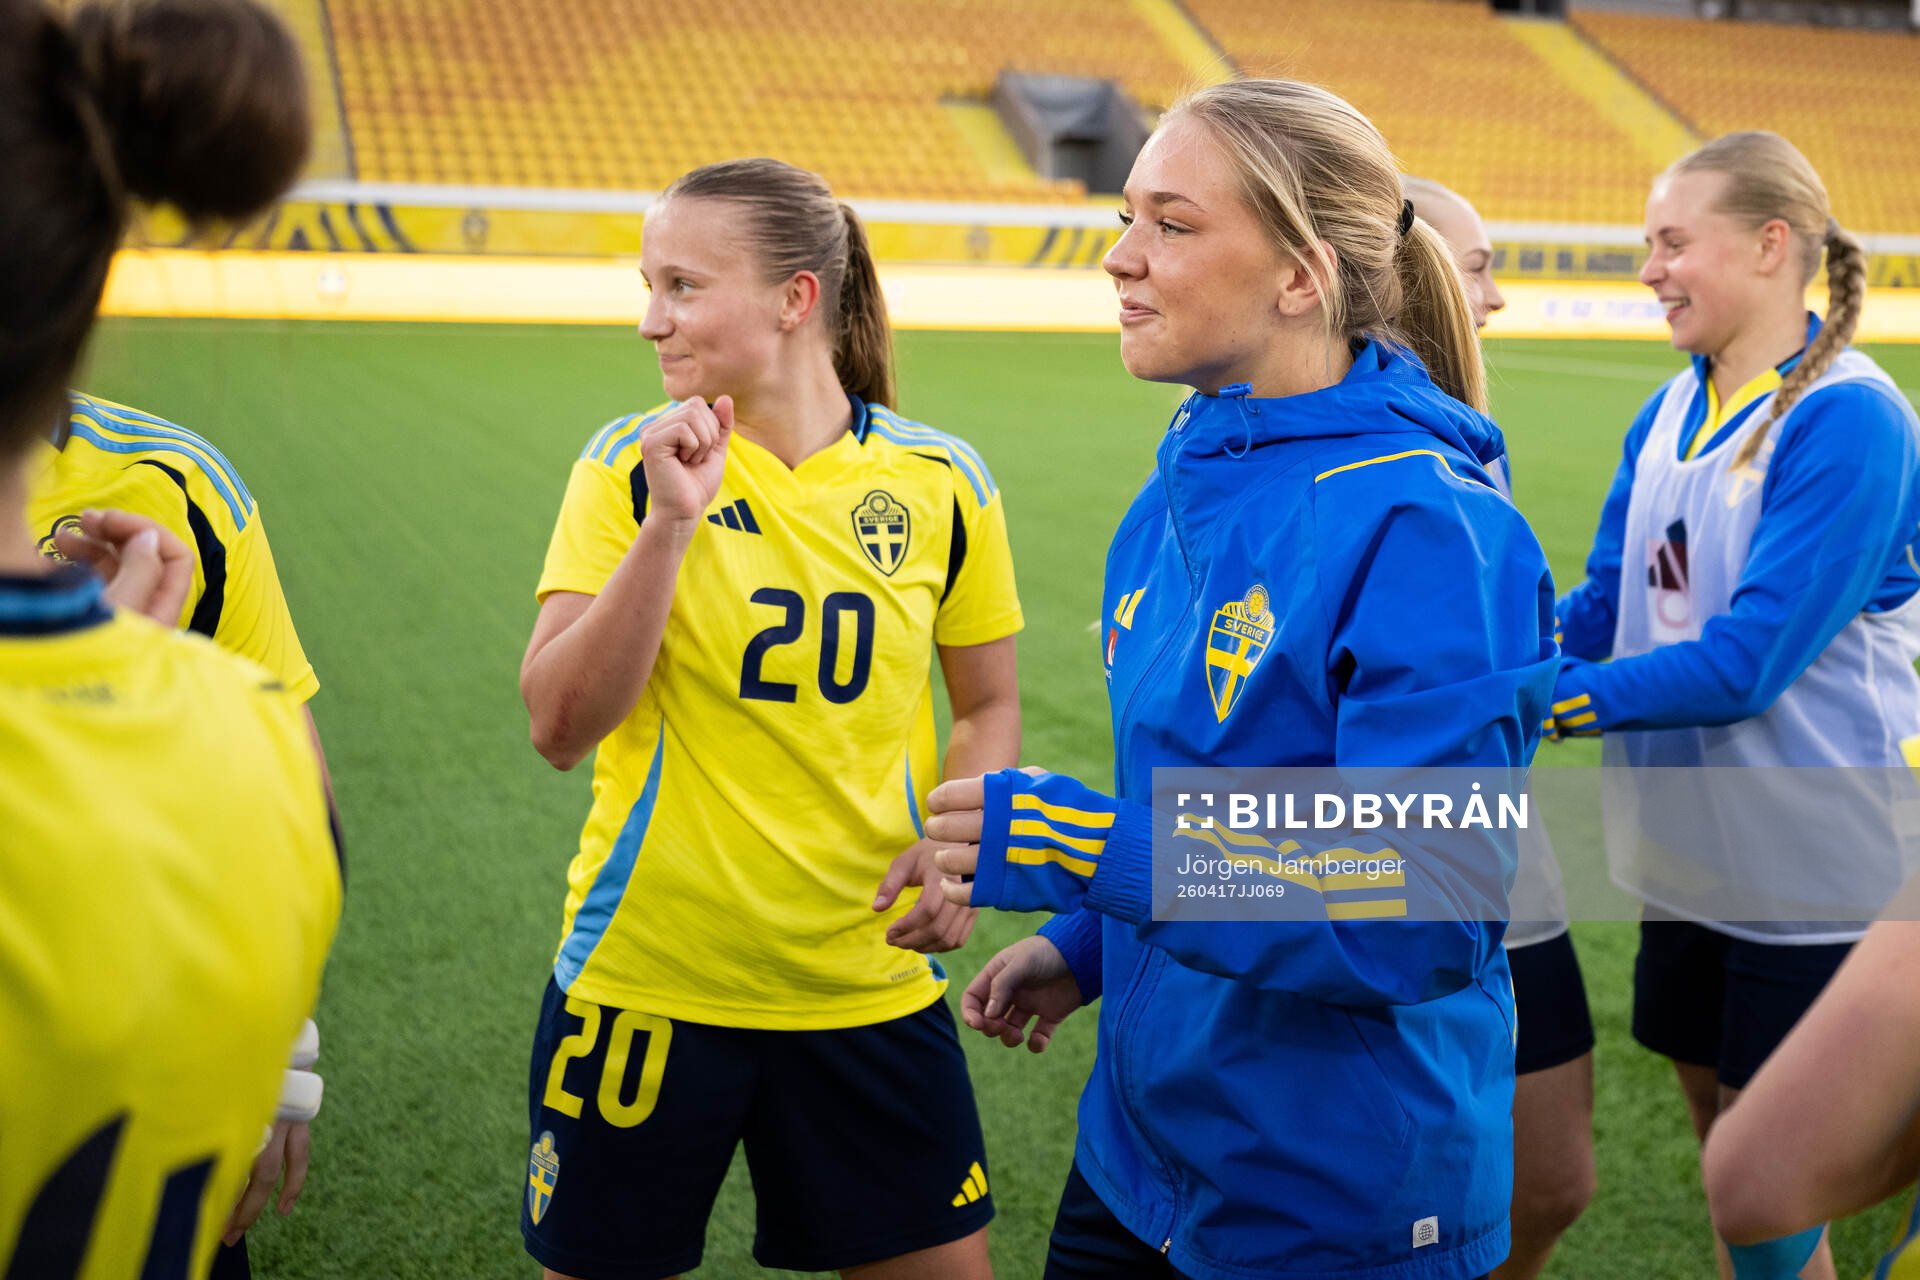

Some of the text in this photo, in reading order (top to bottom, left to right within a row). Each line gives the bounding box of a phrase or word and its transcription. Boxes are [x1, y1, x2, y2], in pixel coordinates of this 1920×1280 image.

[739, 587, 876, 705] 20
[1224, 618, 1265, 641] SVERIGE
[543, 997, 674, 1129] 20
